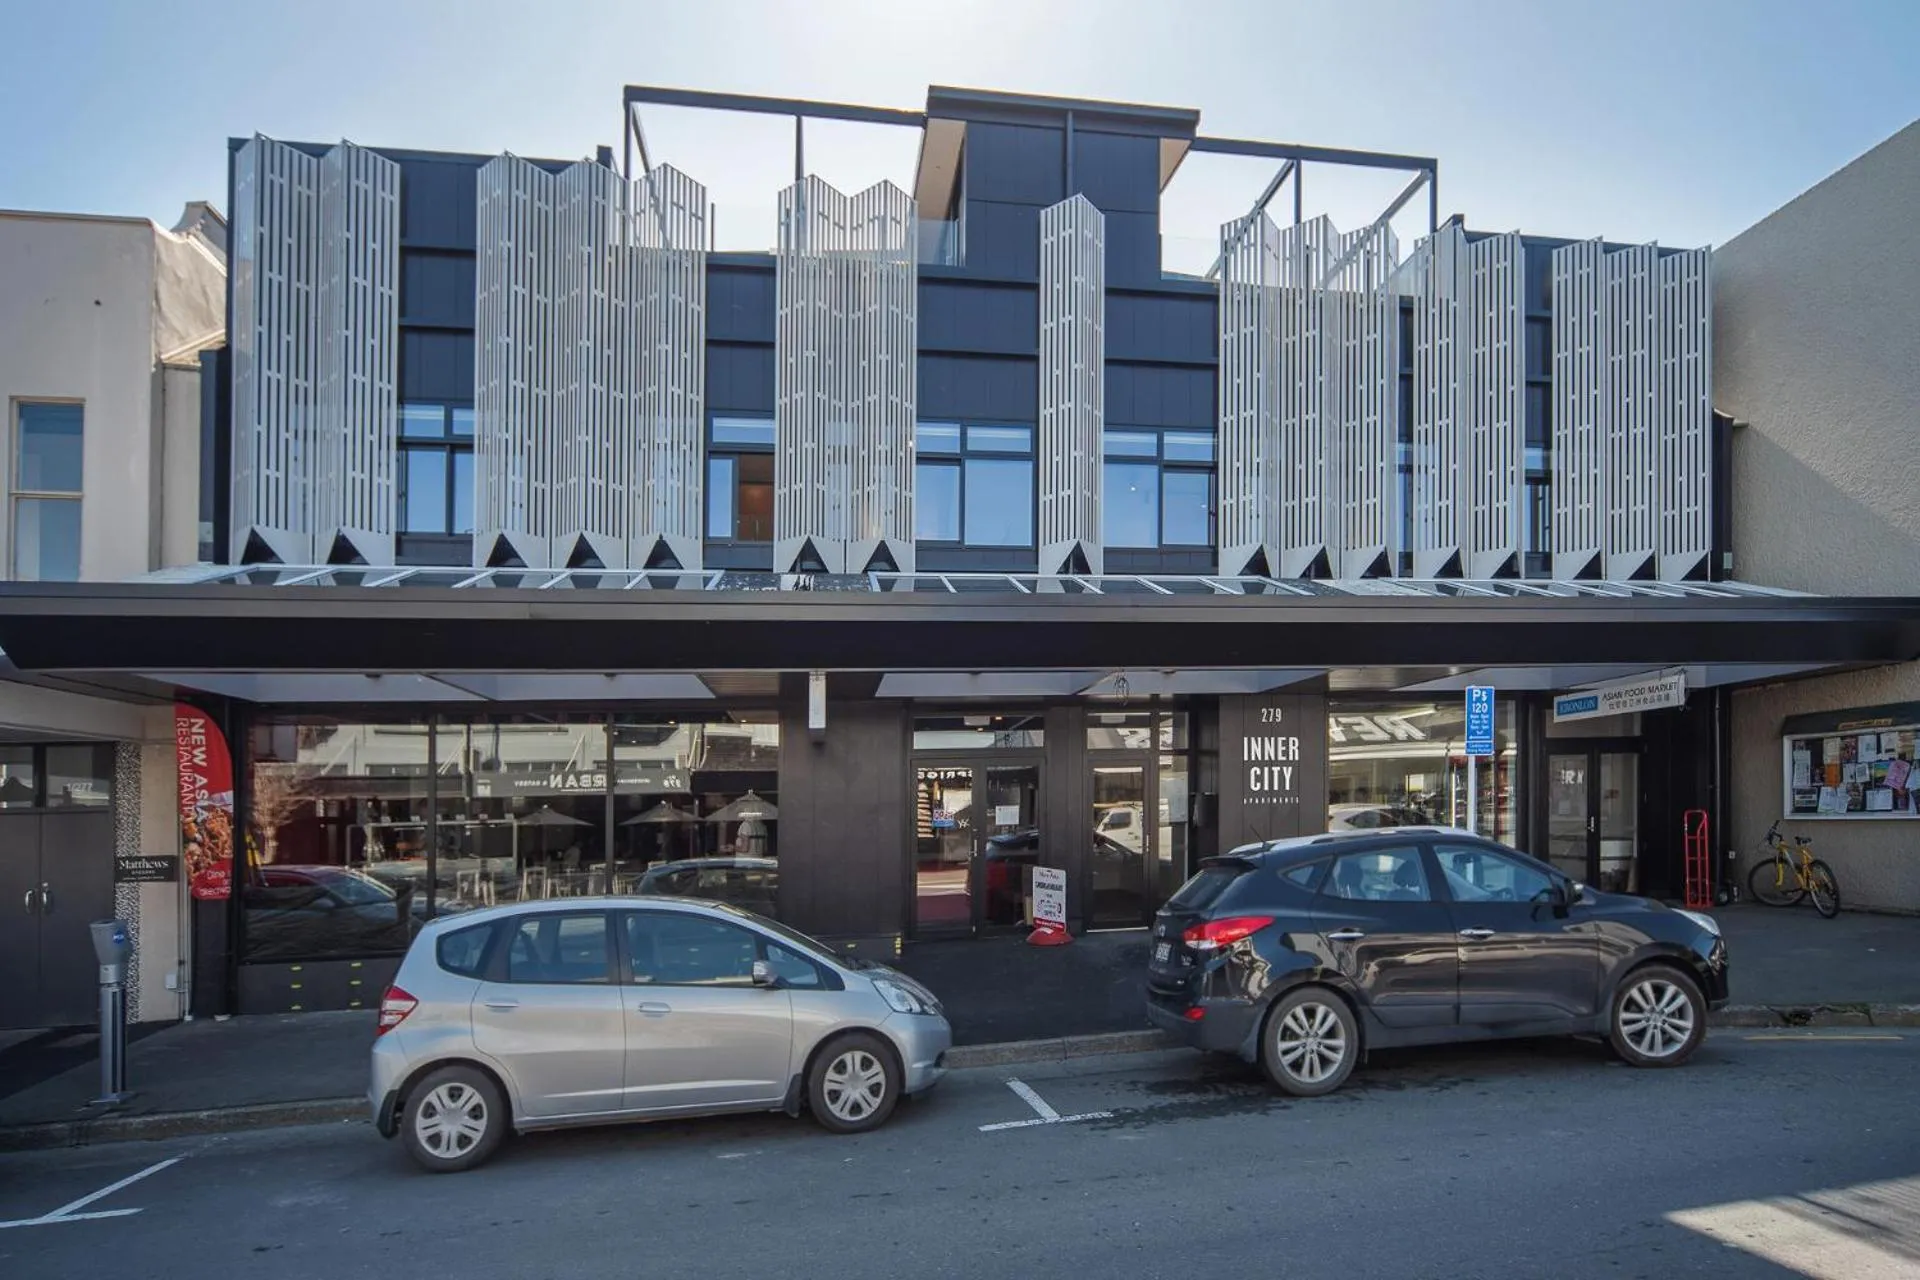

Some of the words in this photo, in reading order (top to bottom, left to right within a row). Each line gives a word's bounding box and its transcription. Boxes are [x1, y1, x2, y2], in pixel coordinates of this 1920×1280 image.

[1602, 690, 1623, 701] ASIAN
[1624, 687, 1646, 698] FOOD
[1648, 681, 1677, 693] MARKET
[1261, 708, 1282, 723] 279
[1472, 702, 1488, 713] 120
[190, 718, 208, 768] NEW
[1243, 736, 1299, 761] INNER
[176, 717, 196, 813] RESTAURANT
[1250, 766, 1293, 791] CITY
[194, 773, 209, 822] ASIA
[119, 858, 169, 870] Matthews
